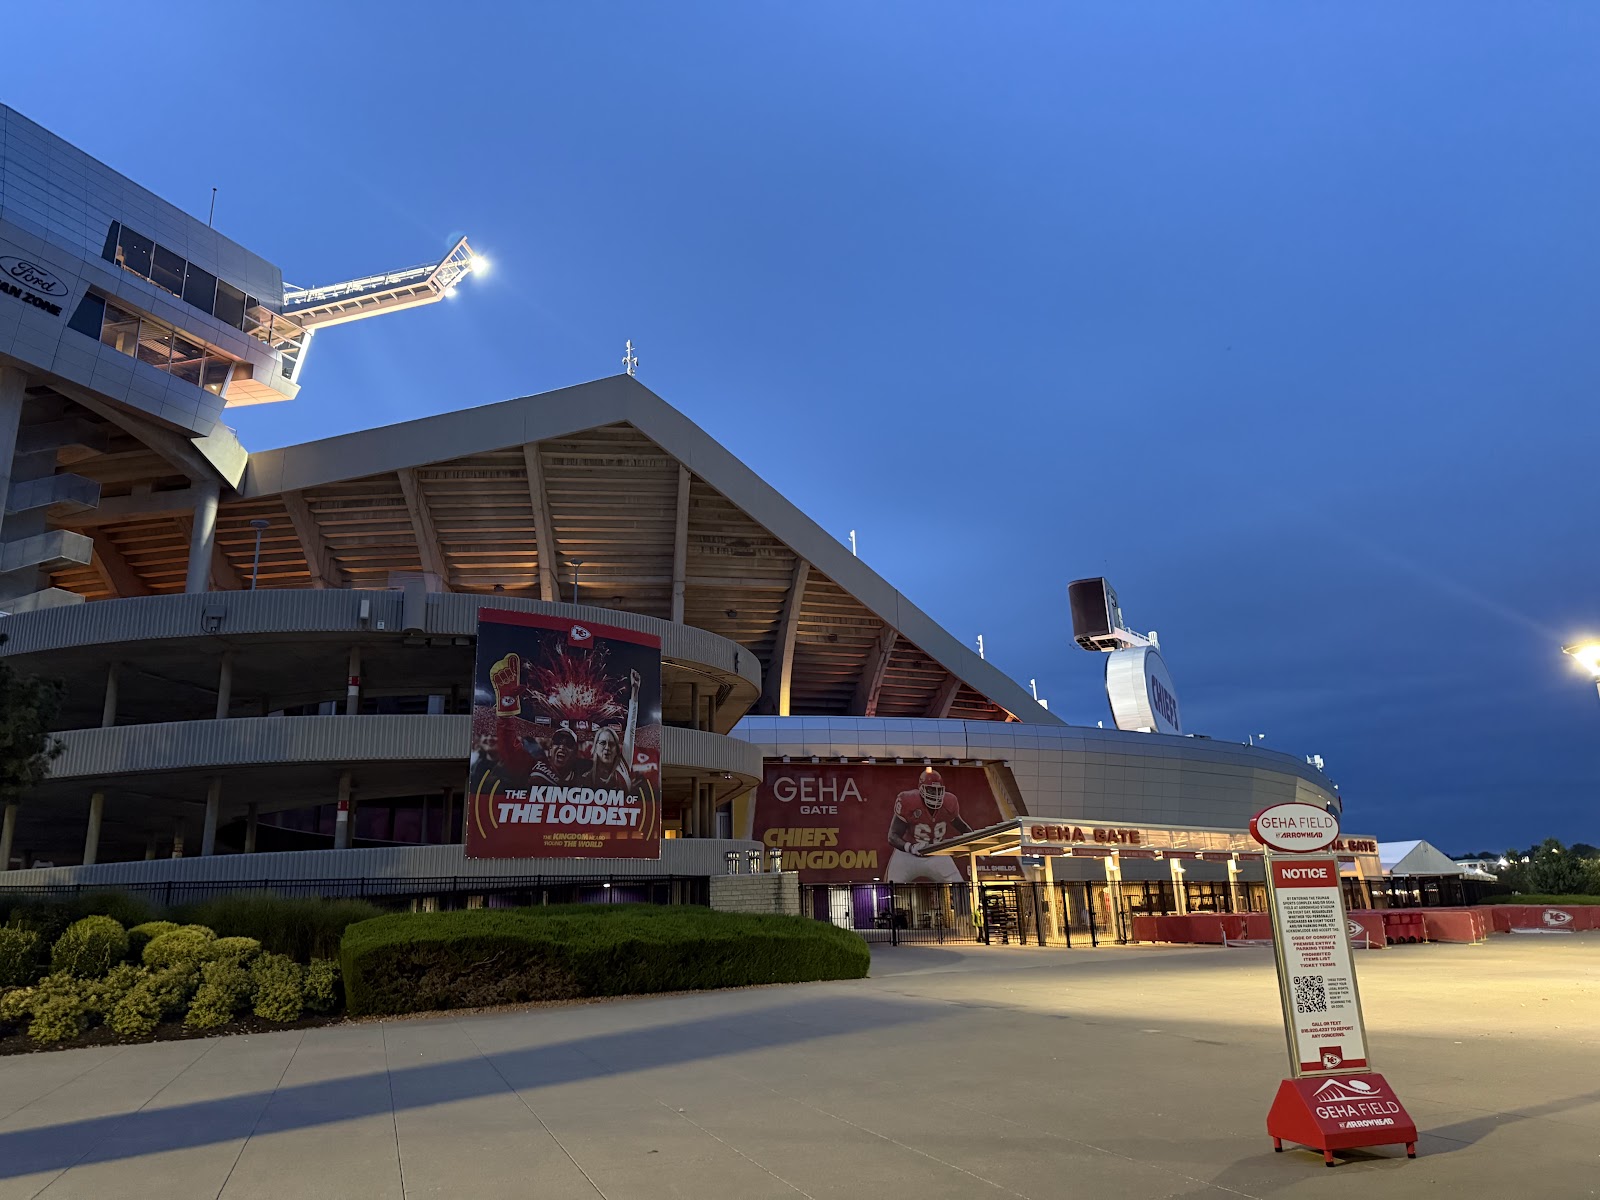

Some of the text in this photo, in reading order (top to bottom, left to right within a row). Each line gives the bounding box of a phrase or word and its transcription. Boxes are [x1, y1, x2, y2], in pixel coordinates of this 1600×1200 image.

[11, 262, 57, 292] Ford
[0, 280, 63, 317] AN ZONE
[1151, 674, 1179, 732] CHIEFS
[505, 785, 639, 806] THE KINGDOM OF
[498, 803, 641, 827] THE LOUDEST
[800, 805, 838, 815] GATE
[1261, 817, 1333, 829] GEHA FIELD
[553, 833, 589, 841] KINGDOM
[763, 827, 840, 847] CHIEFS
[1031, 825, 1141, 844] GEHA GATE
[1281, 831, 1323, 839] ARROWHEAD
[1347, 840, 1376, 852] GATE
[1281, 868, 1328, 879] NOTICE
[1316, 1101, 1400, 1119] GEHA FIELD
[1346, 1118, 1395, 1129] ARROWHEAD
